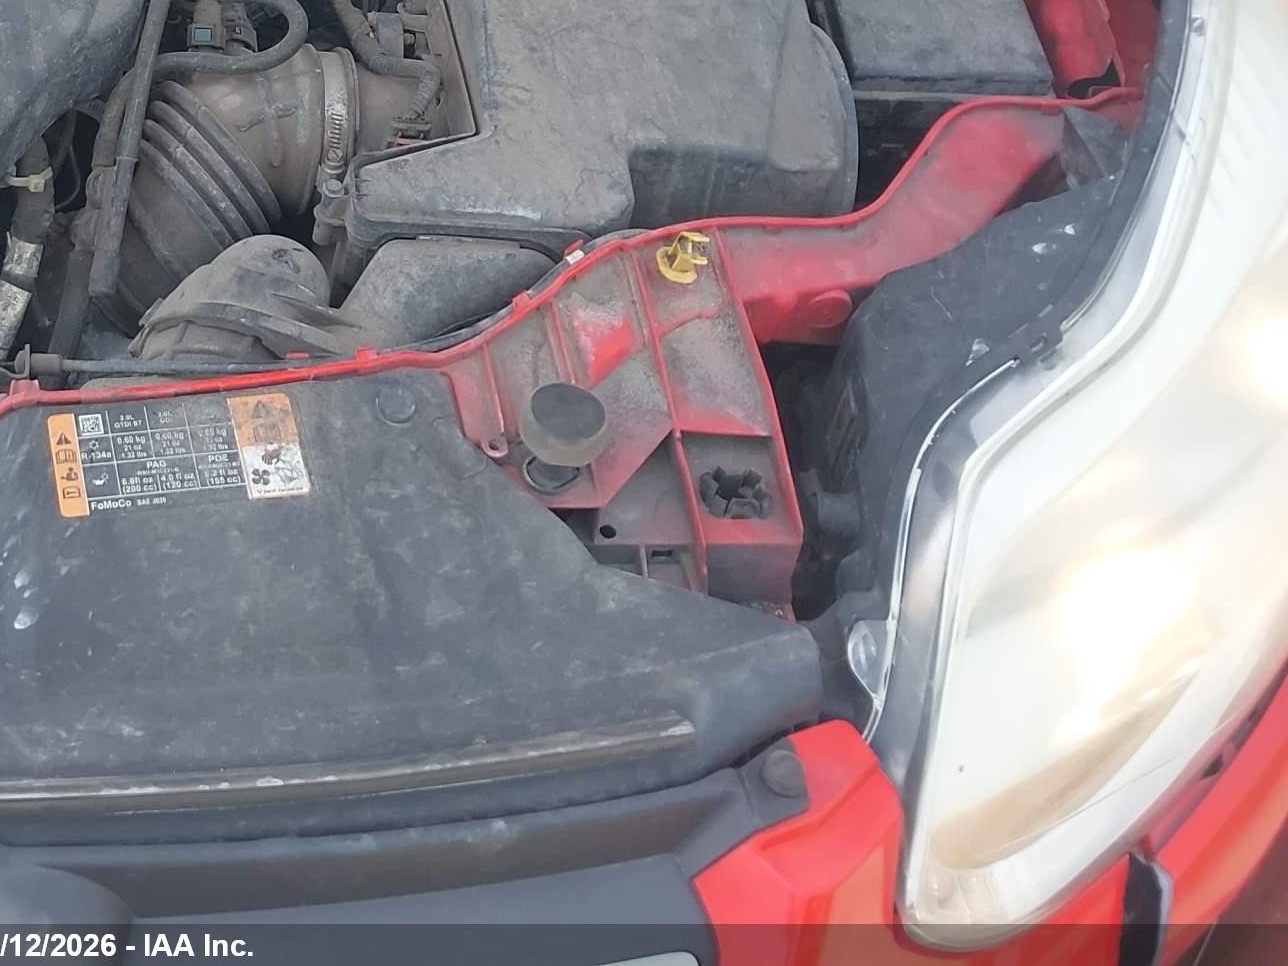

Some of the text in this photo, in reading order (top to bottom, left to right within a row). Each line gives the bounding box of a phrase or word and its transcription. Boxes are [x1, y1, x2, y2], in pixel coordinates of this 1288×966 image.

[215, 426, 226, 437] kg
[116, 434, 146, 445] 0.60 kg
[81, 449, 112, 461] R-134a
[207, 453, 229, 463] POE
[145, 459, 166, 469] PAG
[159, 472, 174, 481] 4.0
[183, 471, 195, 479] oz
[227, 467, 238, 475] oz
[142, 476, 153, 484] oz
[226, 474, 241, 484] cc)
[122, 483, 157, 494] (200 cc)
[161, 479, 197, 491] (120 cc)
[90, 497, 132, 510] FoMoCo
